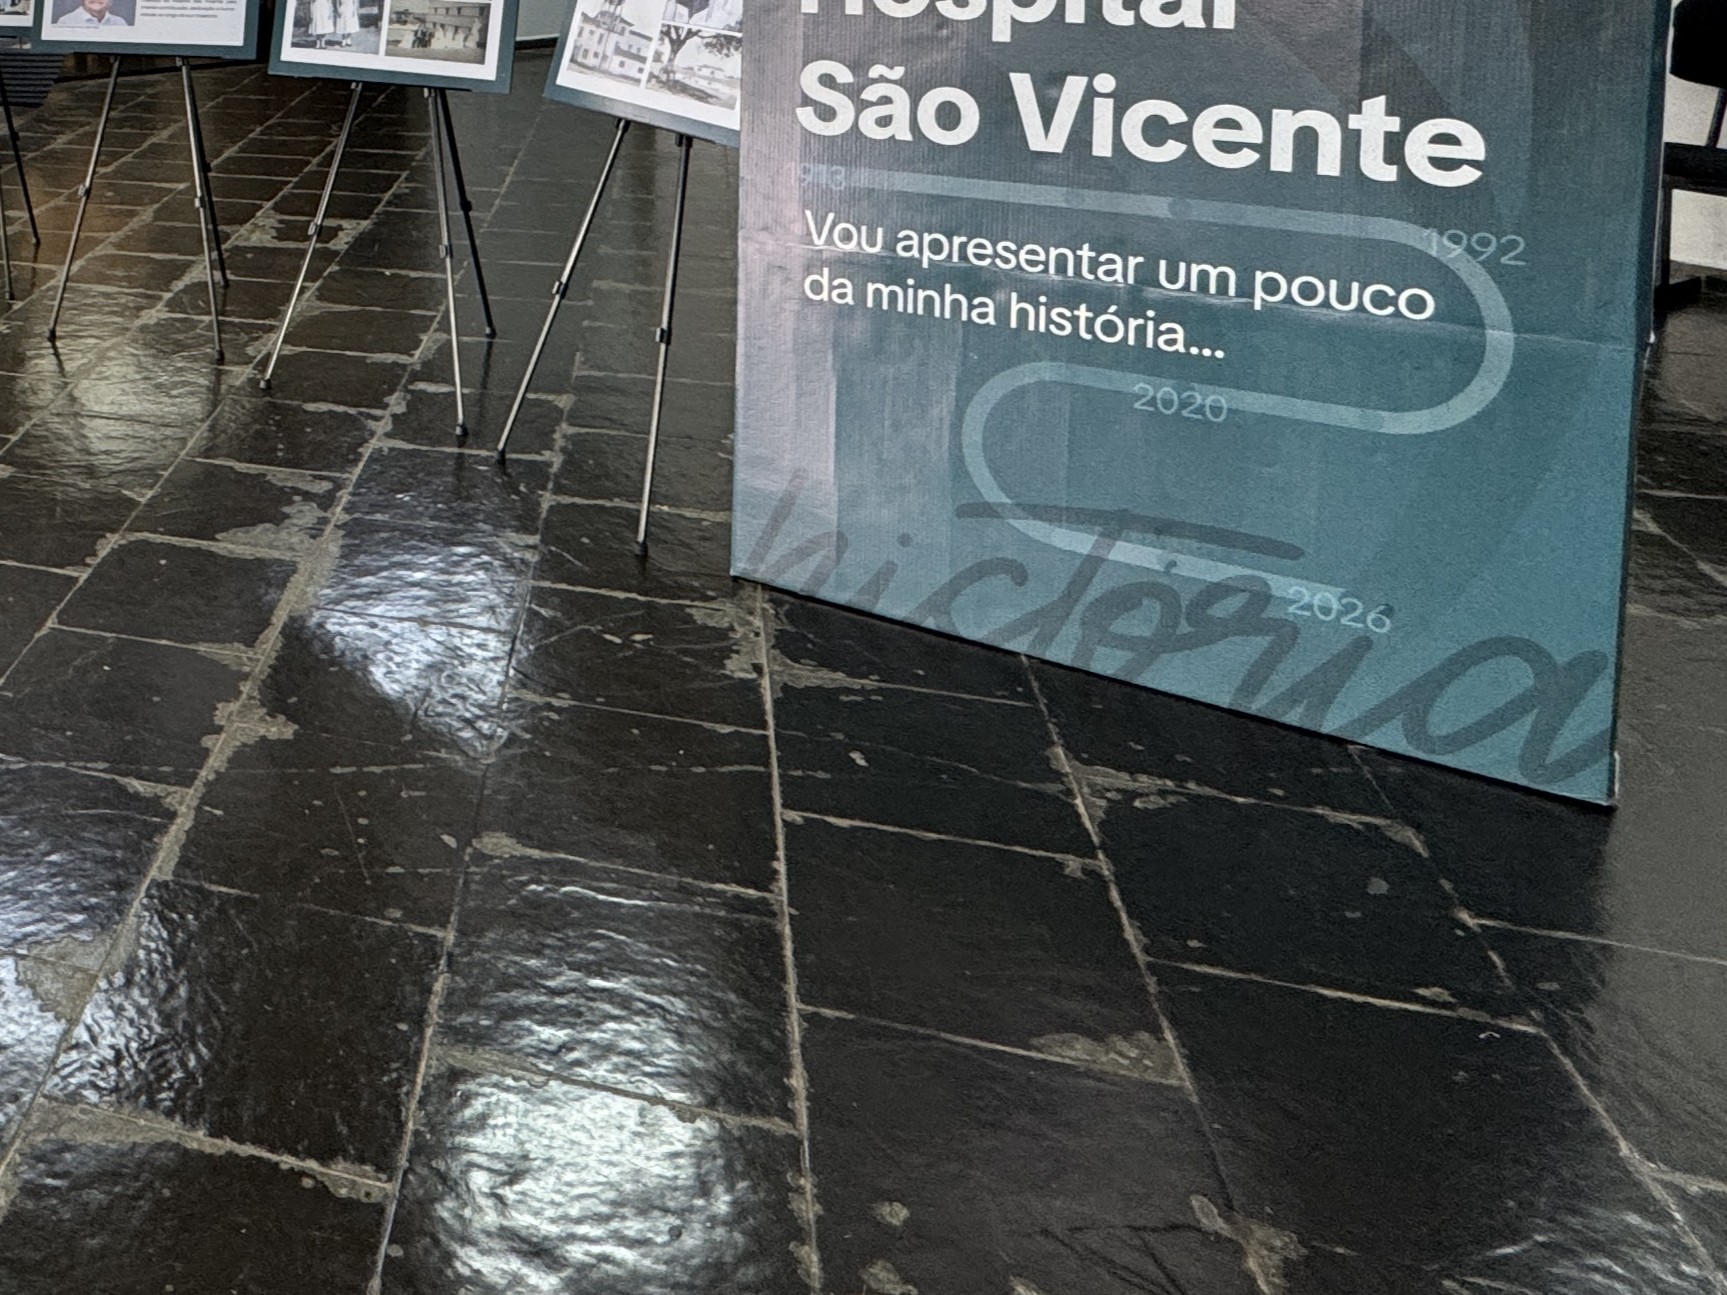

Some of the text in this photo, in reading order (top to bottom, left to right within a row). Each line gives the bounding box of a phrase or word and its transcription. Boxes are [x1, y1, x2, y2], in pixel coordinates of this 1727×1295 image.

[795, 58, 1487, 188] São Vicente
[804, 209, 1437, 322] Vou apresentar um pouco
[1423, 228, 1527, 266] 1992
[803, 268, 1226, 360] da minha história...
[1133, 382, 1228, 423] 2020
[1288, 586, 1394, 633] 2026
